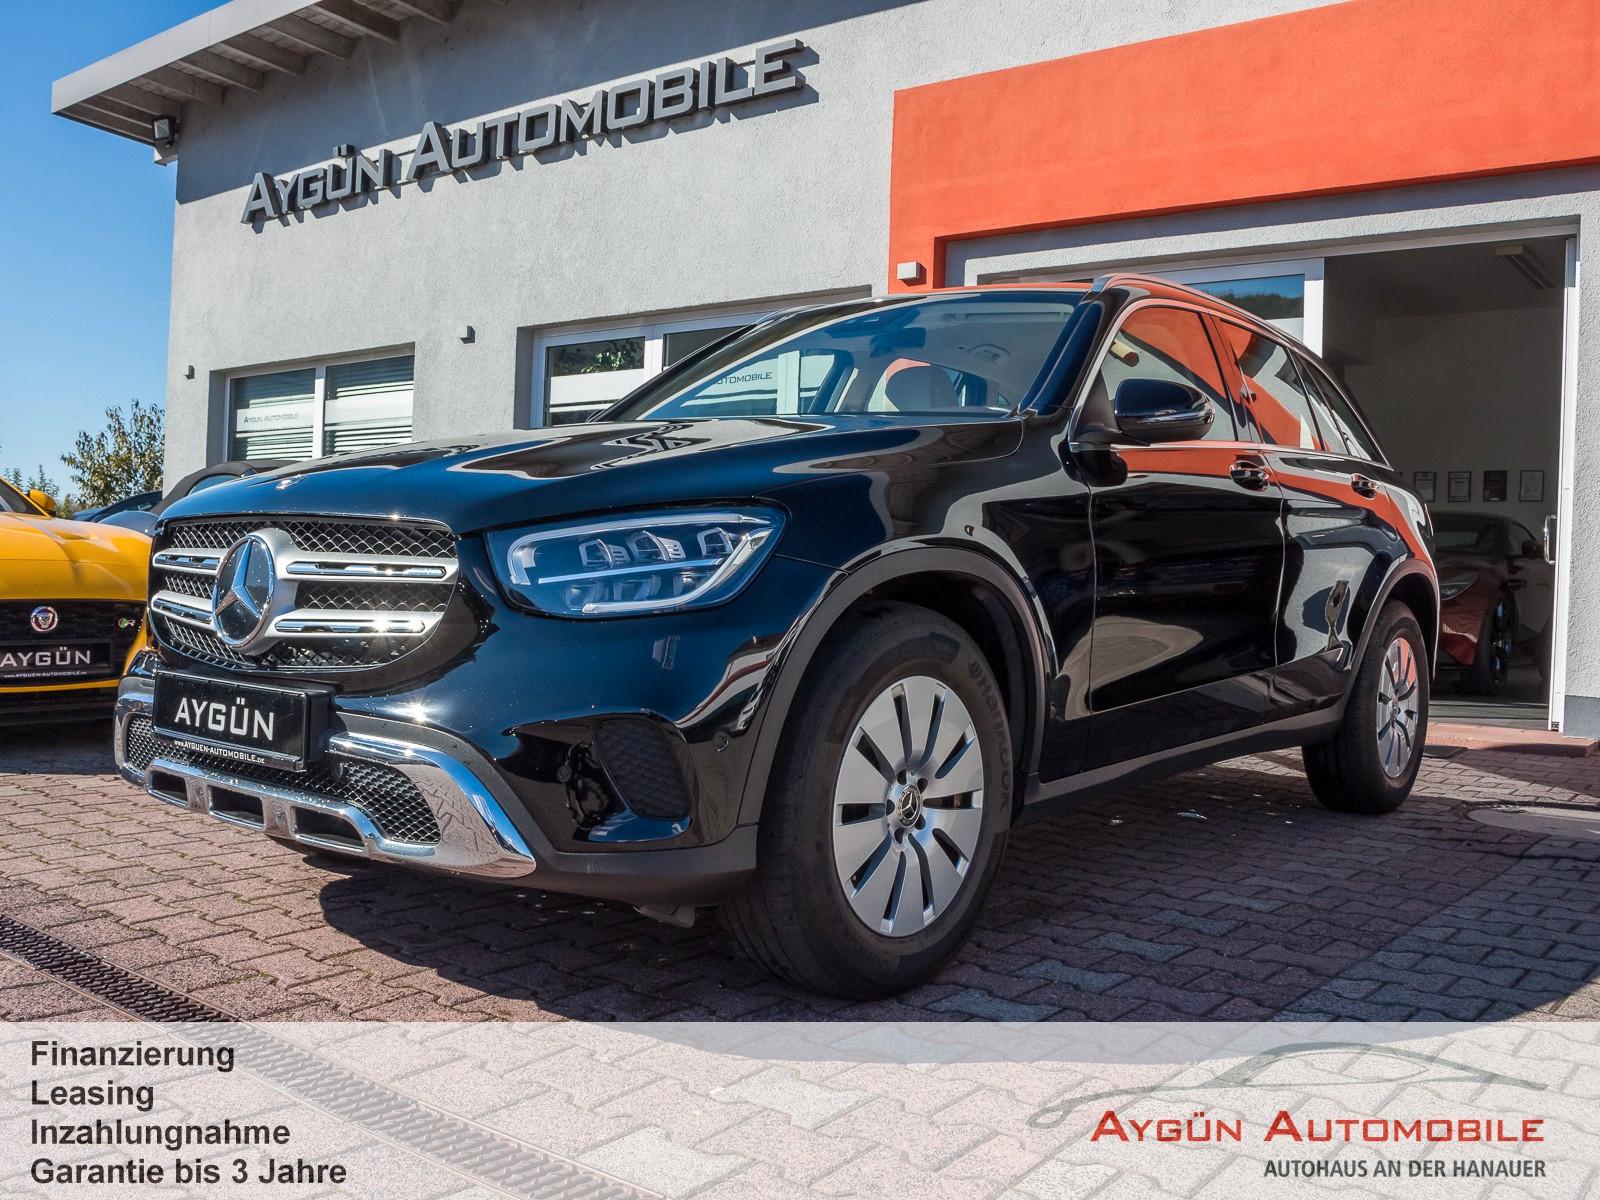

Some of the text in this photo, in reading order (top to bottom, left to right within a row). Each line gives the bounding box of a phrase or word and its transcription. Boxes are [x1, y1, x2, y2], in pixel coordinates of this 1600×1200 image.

[240, 38, 804, 224] AYGÜN AUTOMOBILE
[714, 371, 773, 385] UTOMOBILE
[0, 646, 91, 668] AYGÜN
[174, 697, 275, 741] AYGÜN
